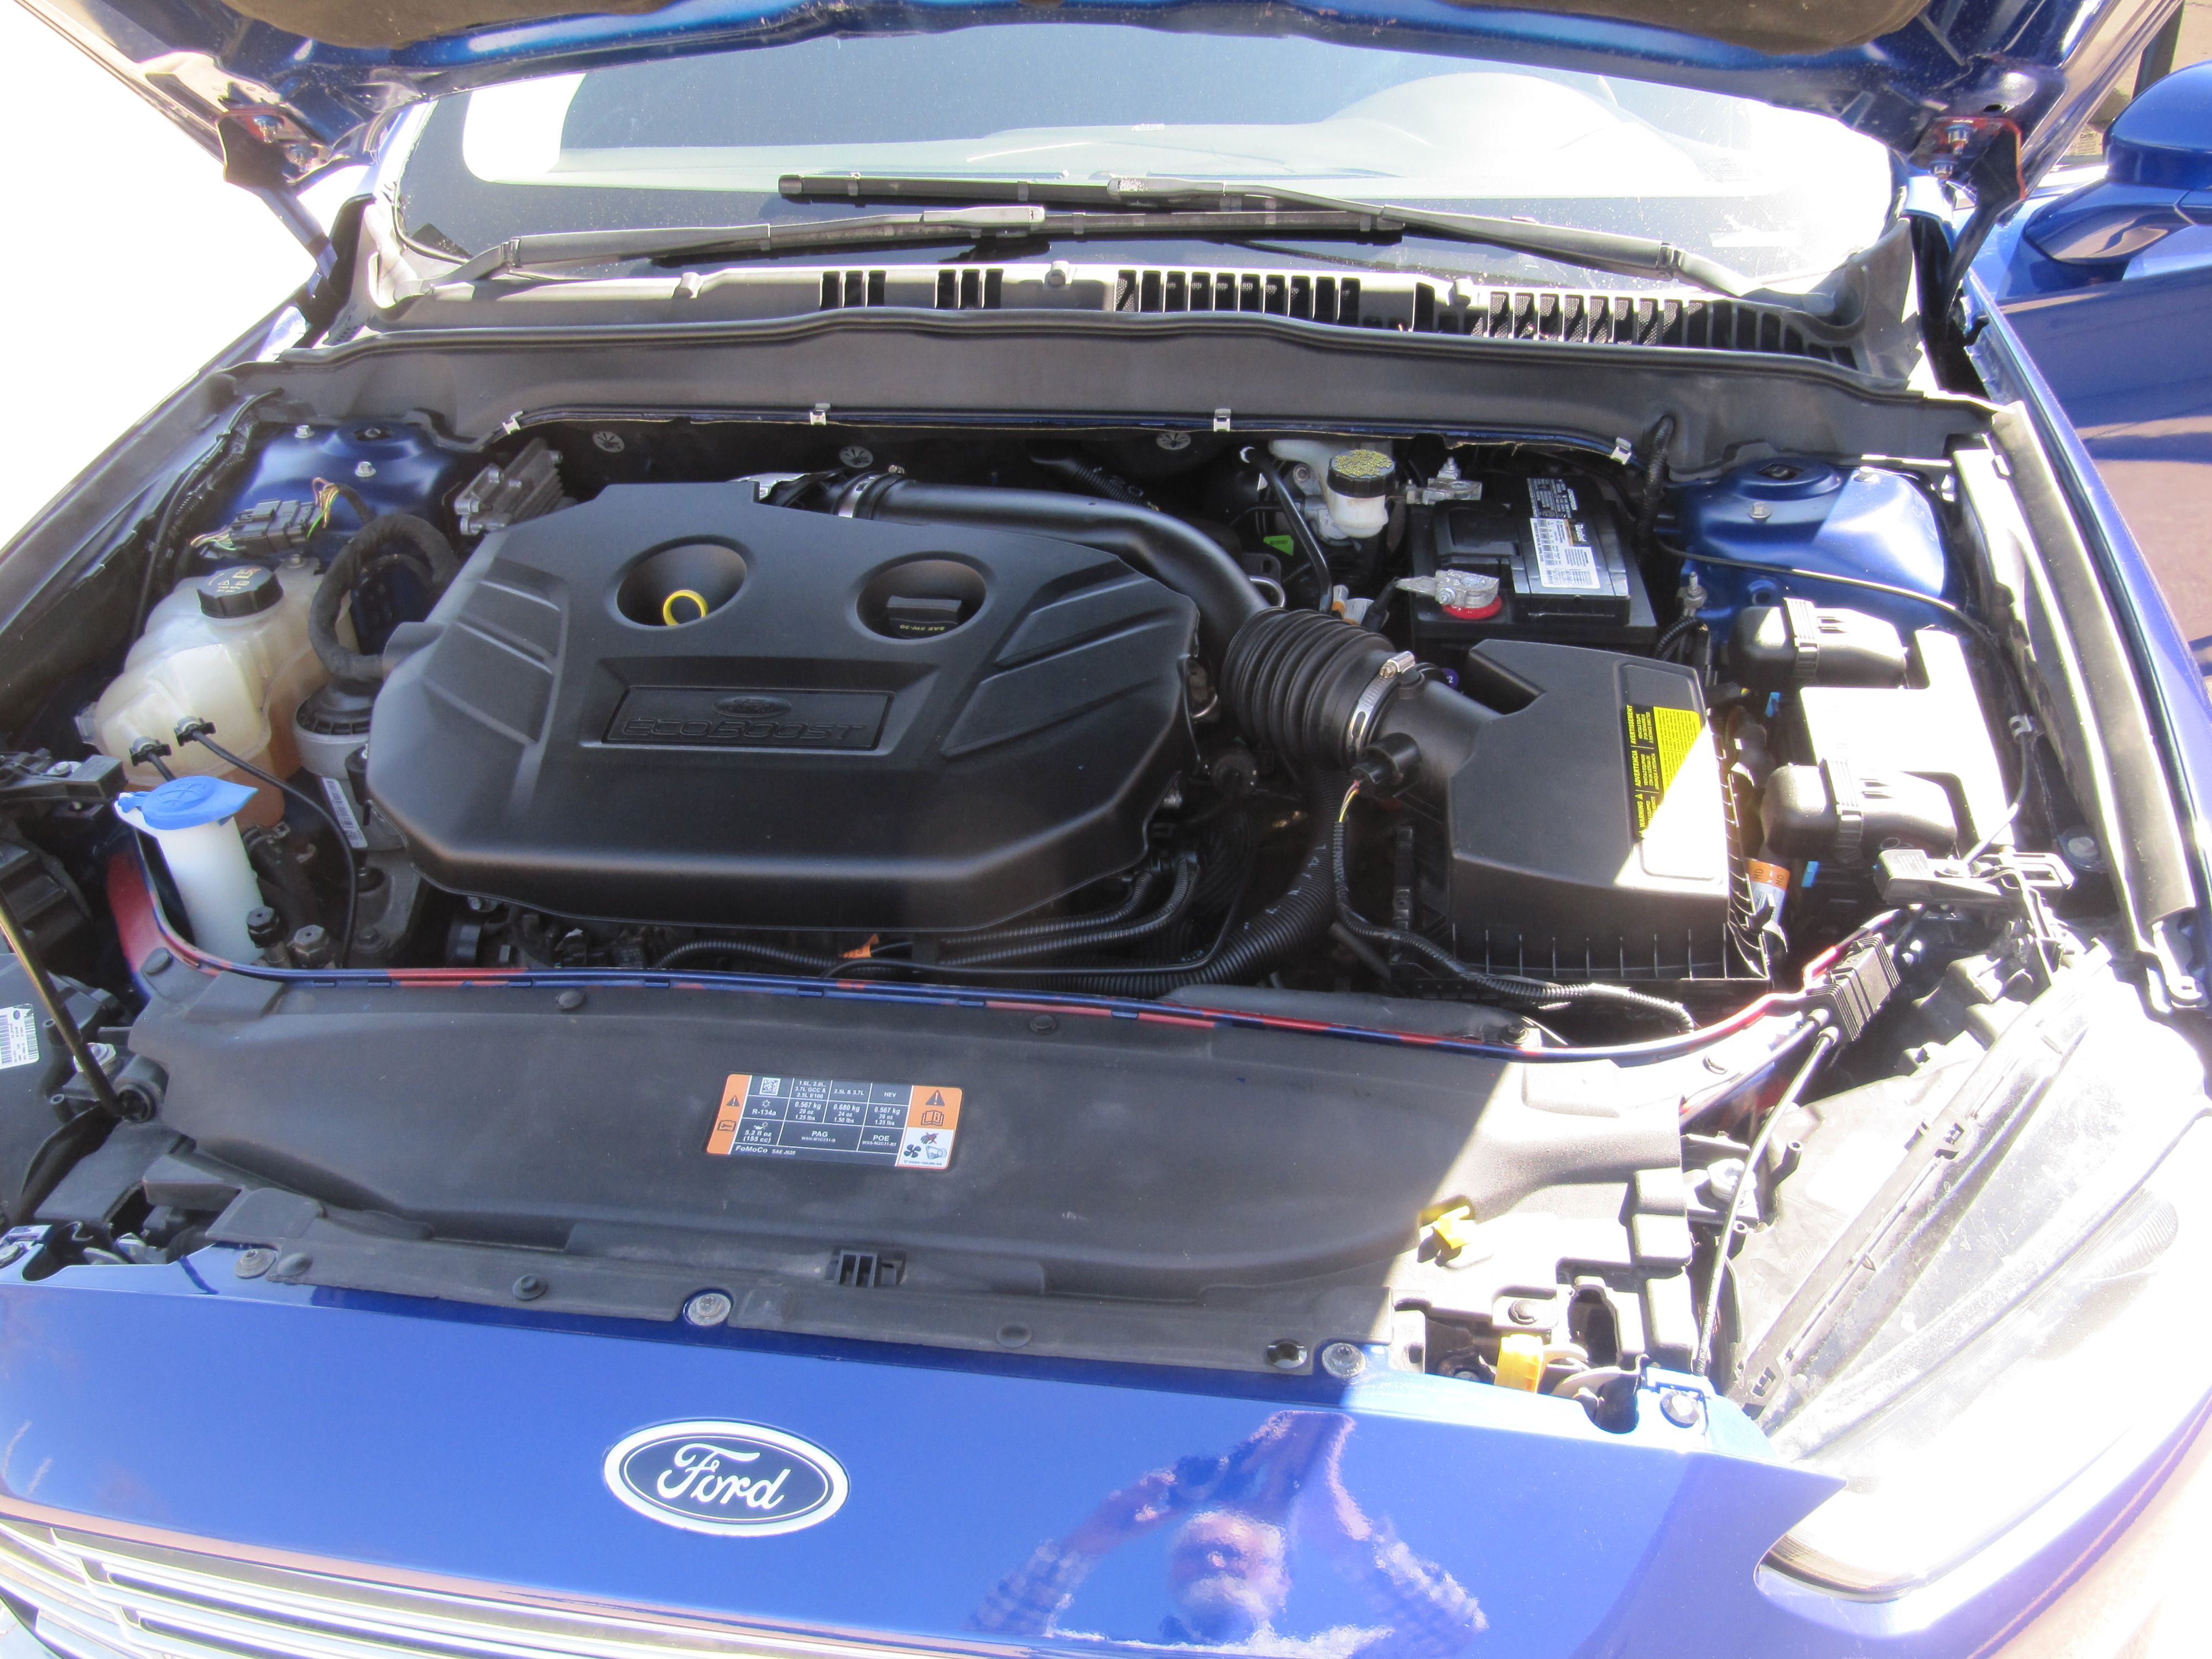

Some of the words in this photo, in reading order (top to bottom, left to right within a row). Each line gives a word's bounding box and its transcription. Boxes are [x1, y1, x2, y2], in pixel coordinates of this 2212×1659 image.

[1626, 705, 1636, 744] AVERTISSEMENT
[1631, 750, 1641, 787] ADVERTENCIA
[1637, 801, 1646, 827] WARNING
[1754, 868, 1764, 880] MD
[892, 1107, 901, 1115] kg
[735, 1145, 768, 1154] FoMoCo
[657, 1442, 791, 1509] Ford
